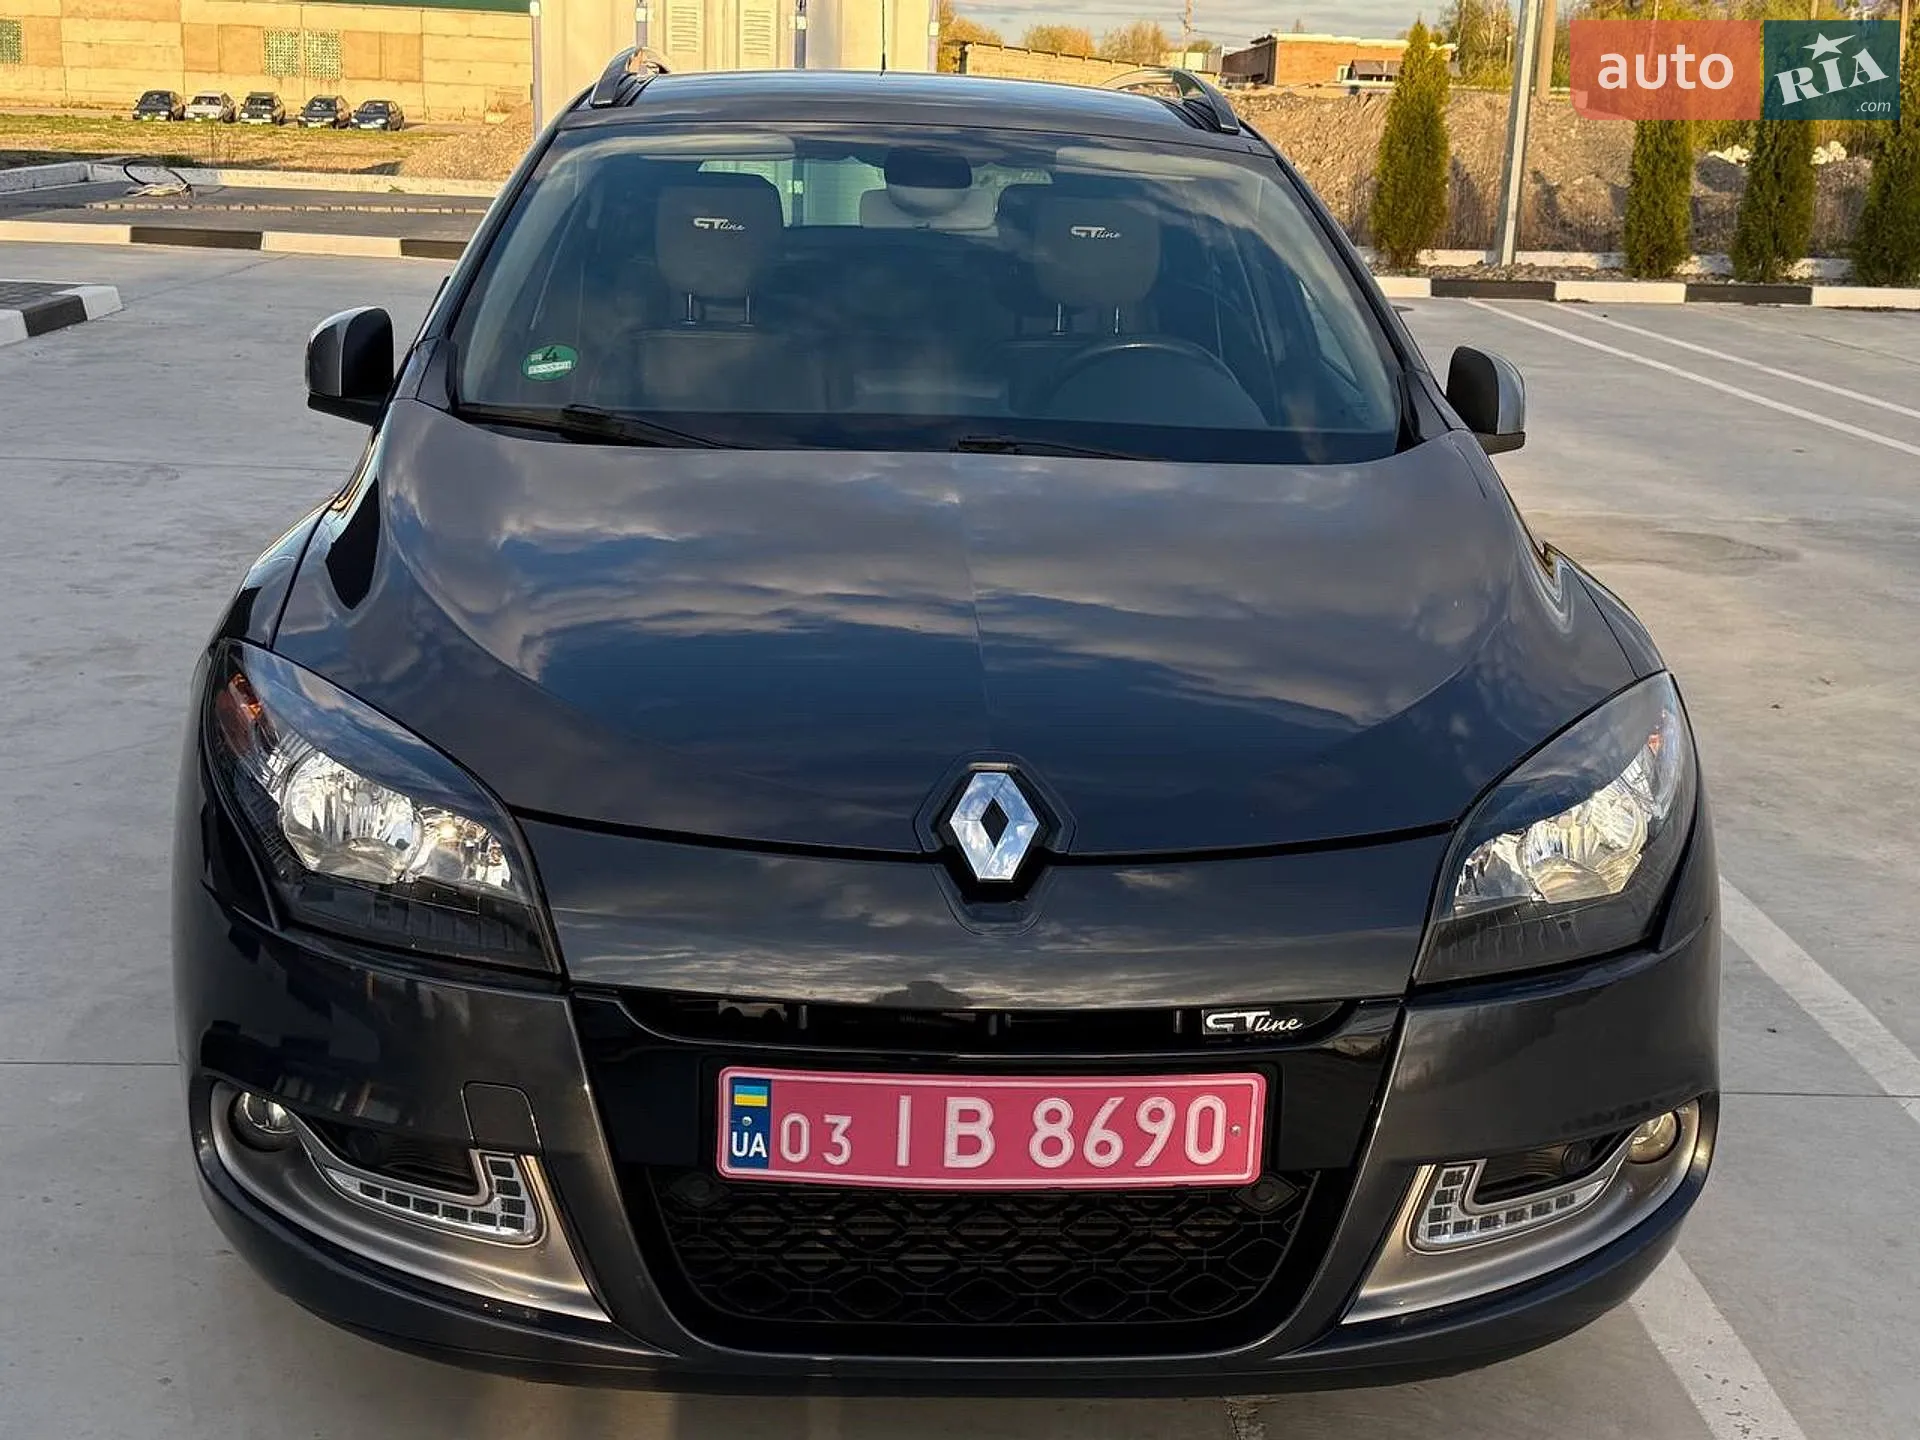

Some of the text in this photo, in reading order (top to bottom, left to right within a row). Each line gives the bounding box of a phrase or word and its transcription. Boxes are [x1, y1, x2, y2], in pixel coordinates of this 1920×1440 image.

[731, 1131, 768, 1158] UA
[780, 1112, 852, 1166] 03
[1029, 1095, 1227, 1168] 8690
